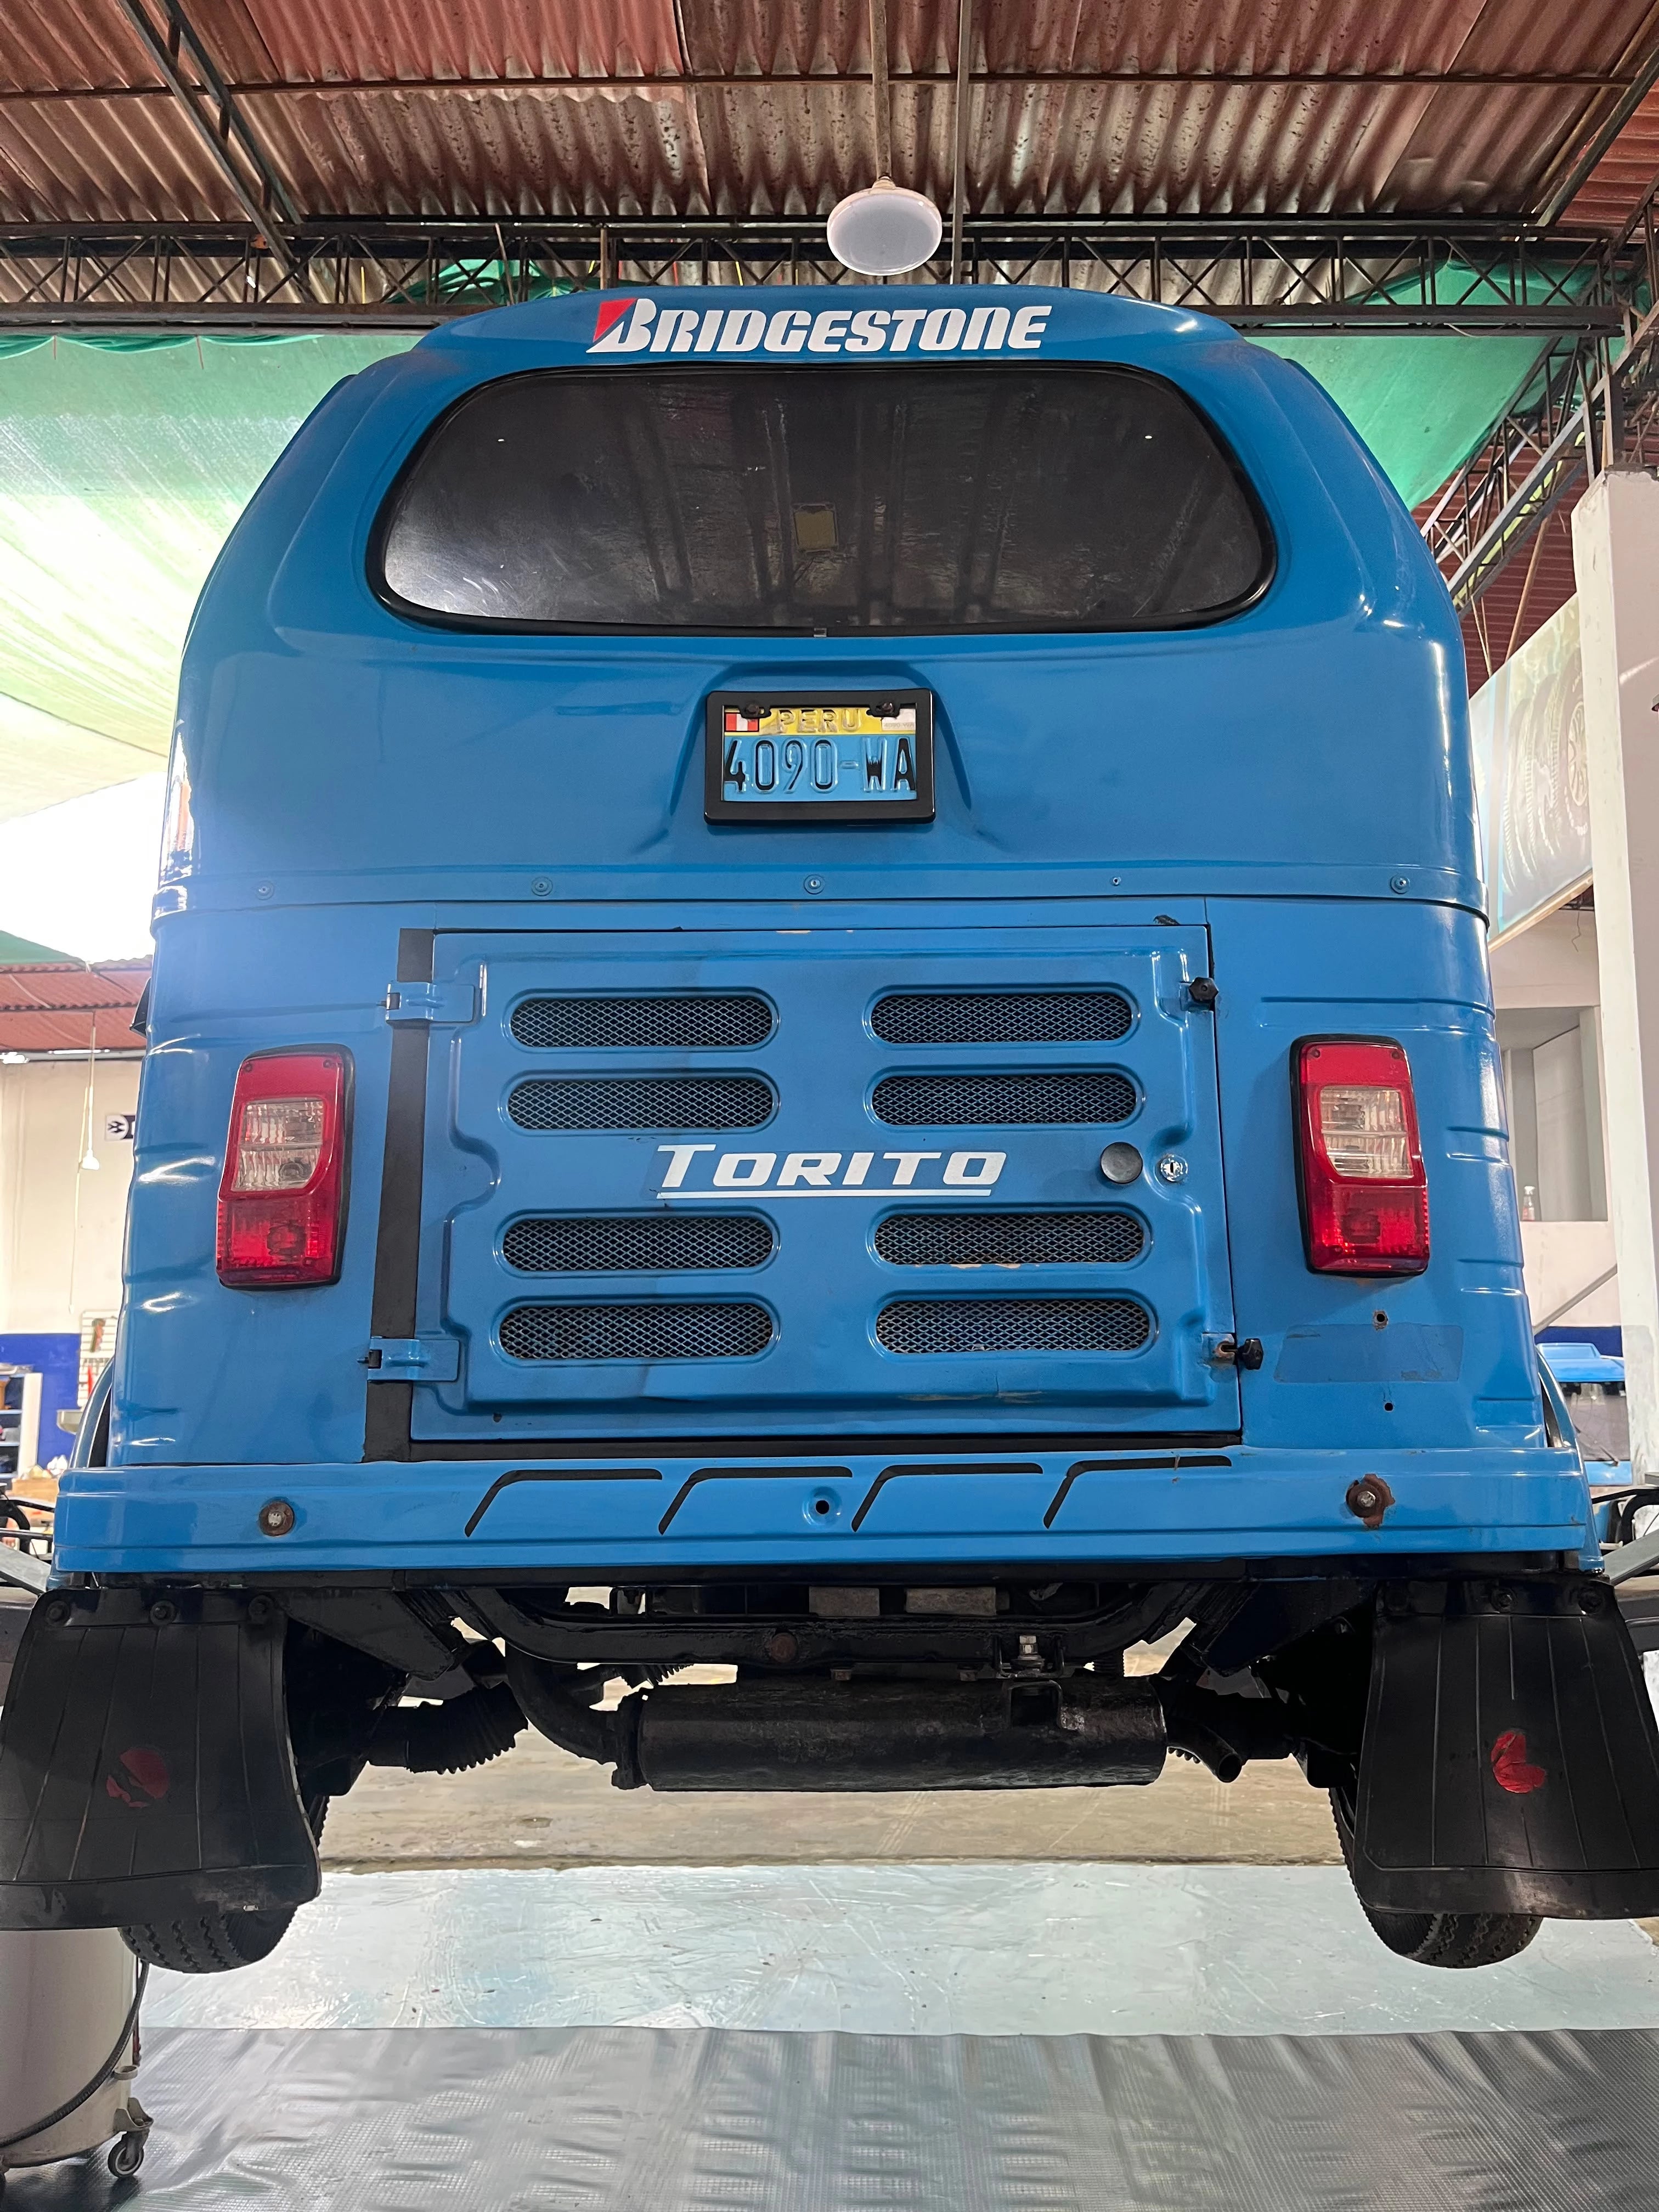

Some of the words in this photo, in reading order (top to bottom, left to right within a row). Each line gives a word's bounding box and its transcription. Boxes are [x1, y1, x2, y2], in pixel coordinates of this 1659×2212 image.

[586, 298, 1052, 353] BRIDGESTONE
[777, 708, 862, 733] PERU
[724, 737, 916, 794] 4090-WA
[657, 1144, 1007, 1188] TORITO
